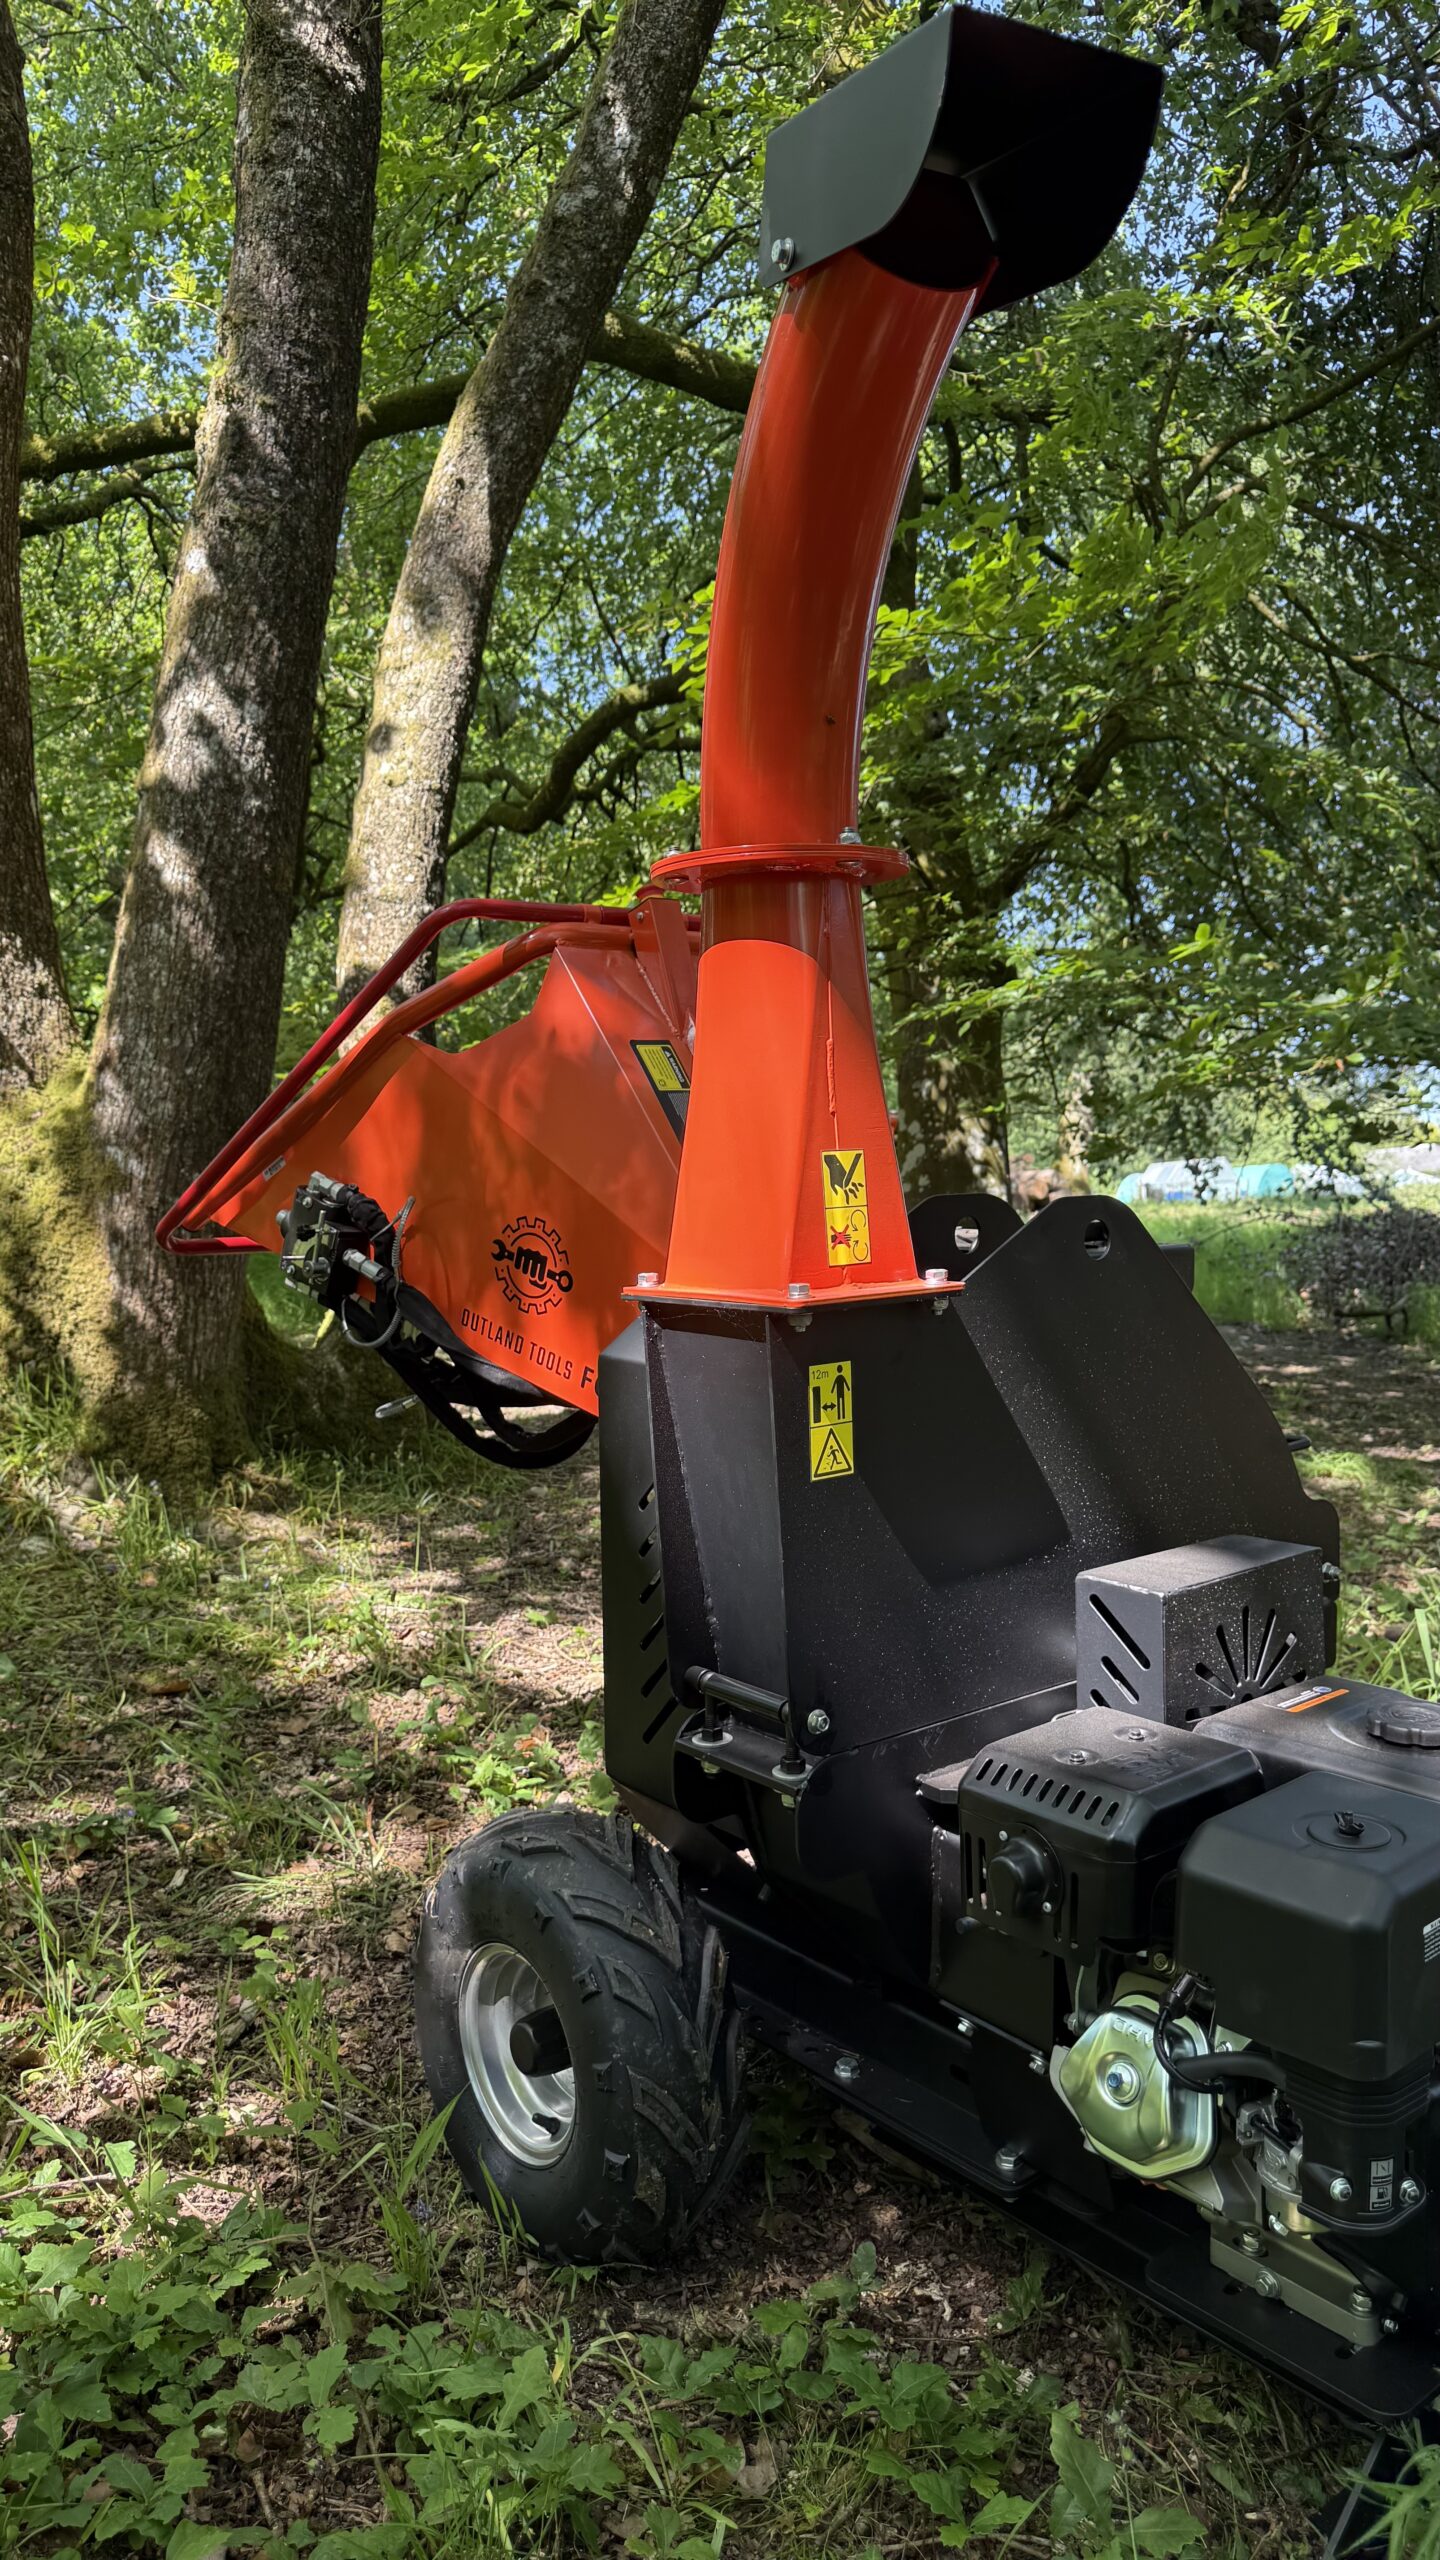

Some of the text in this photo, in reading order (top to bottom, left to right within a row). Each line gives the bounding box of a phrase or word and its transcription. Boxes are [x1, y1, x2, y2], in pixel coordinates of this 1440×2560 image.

[461, 1308, 524, 1354] OUTLAND
[530, 1341, 573, 1380] TOOLS
[812, 1369, 829, 1381] 12m
